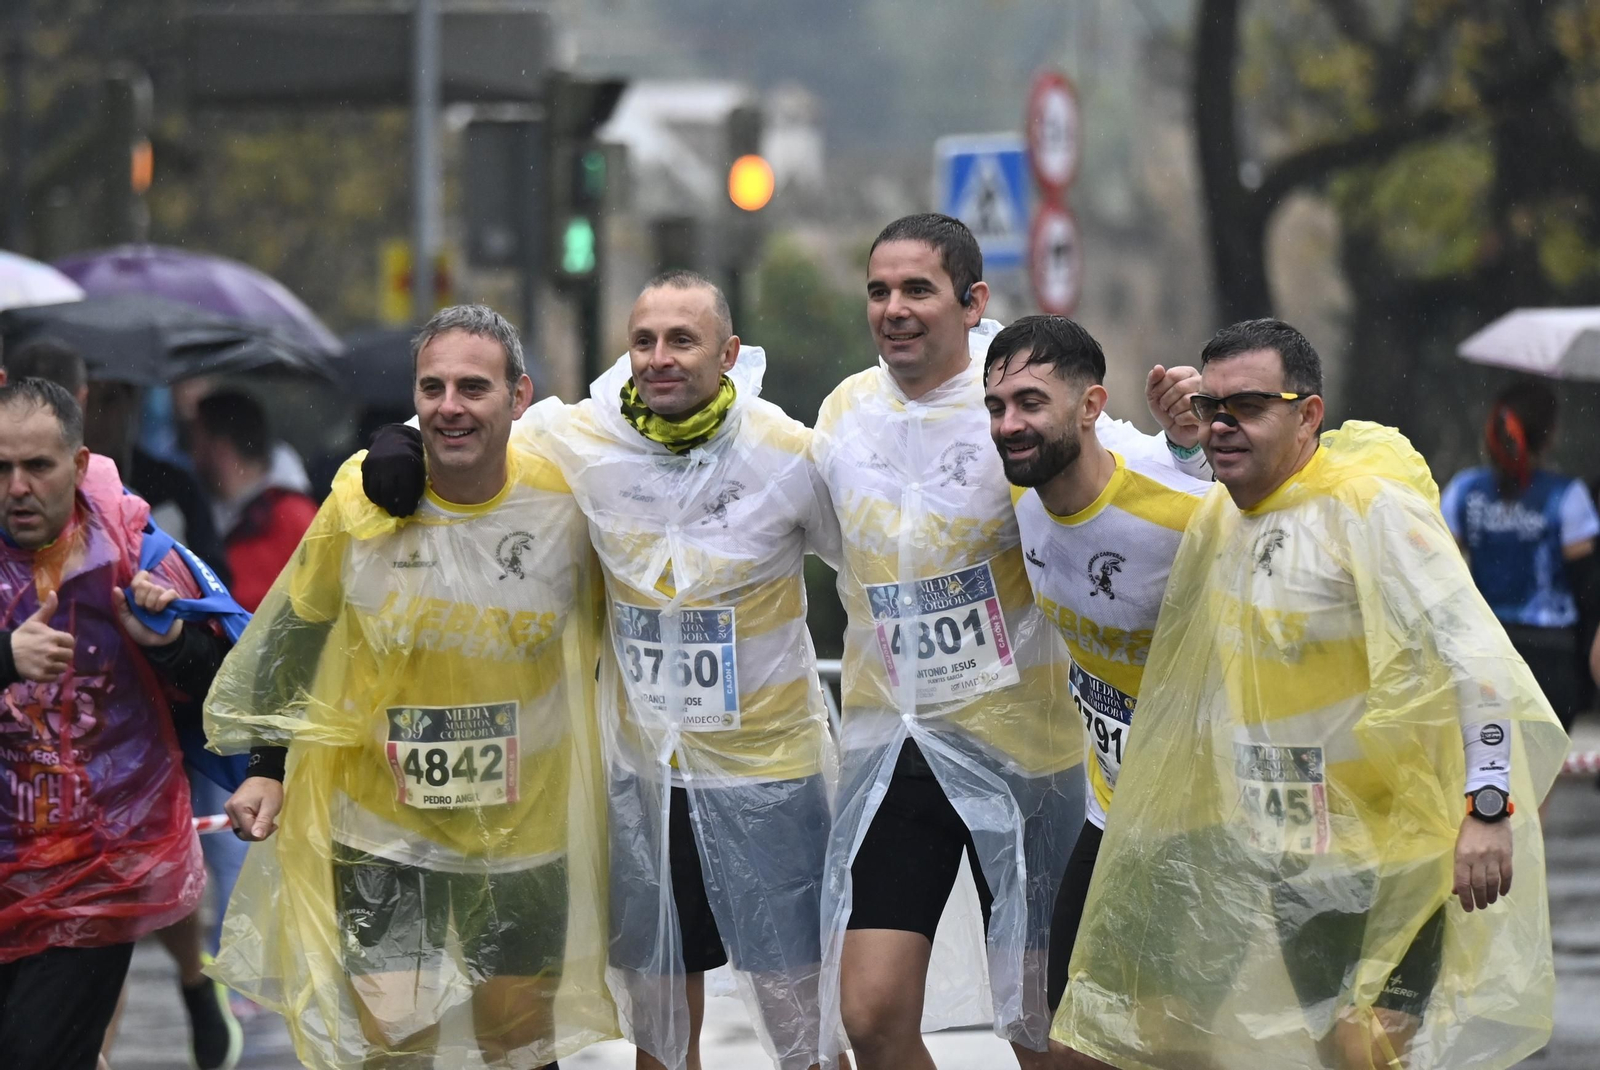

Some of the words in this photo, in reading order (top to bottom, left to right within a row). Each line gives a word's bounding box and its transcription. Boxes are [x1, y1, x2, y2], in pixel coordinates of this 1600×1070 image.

[846, 488, 1005, 549] LIERES
[918, 575, 964, 595] MEDIA
[890, 608, 986, 661] 4801
[625, 644, 719, 689] 3760
[950, 659, 977, 674] JESUS
[1088, 677, 1121, 701] MEDIA
[445, 707, 491, 721] MEDIA
[683, 715, 721, 724] IMDECO
[403, 743, 504, 787] 4842
[423, 795, 452, 805] PEDRO
